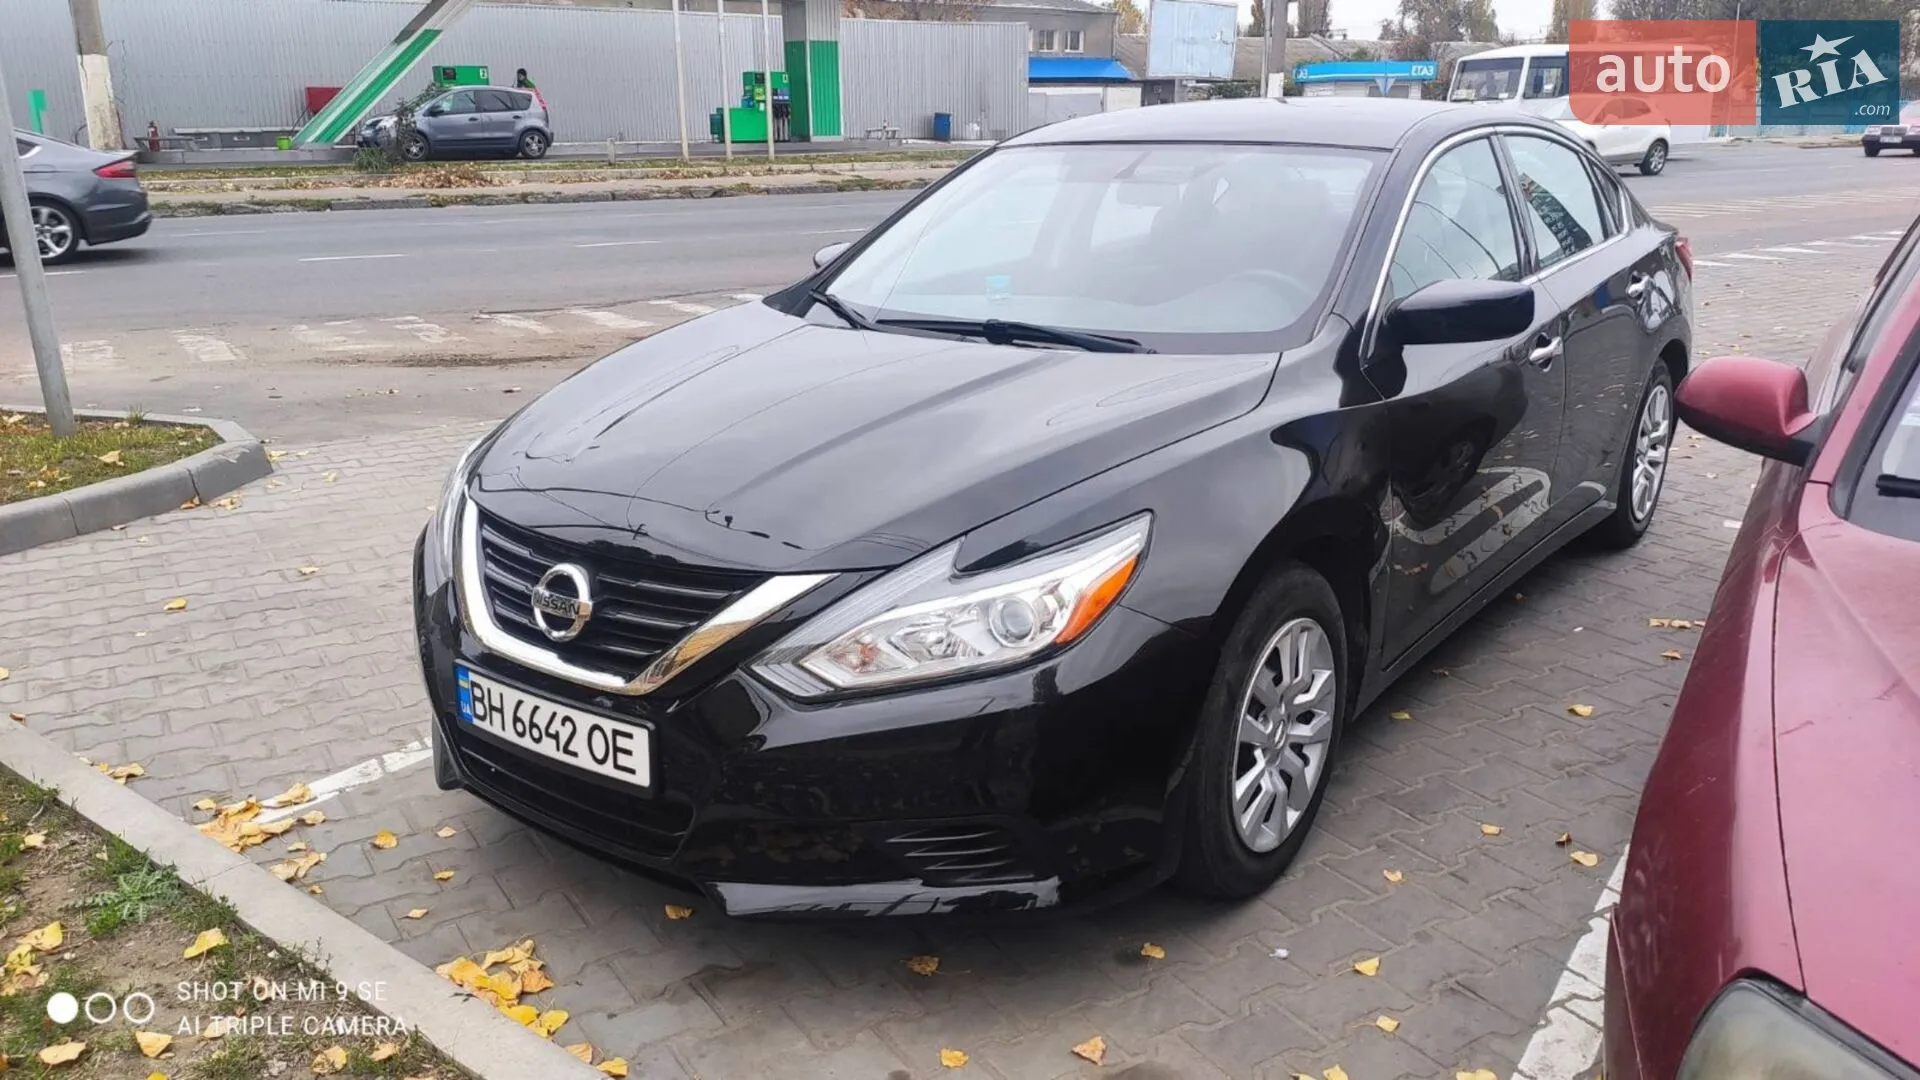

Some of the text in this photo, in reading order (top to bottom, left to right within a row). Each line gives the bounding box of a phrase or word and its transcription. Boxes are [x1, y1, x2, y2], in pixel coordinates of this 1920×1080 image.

[534, 589, 580, 616] NISSAN
[470, 680, 637, 776] BH 6642 OE
